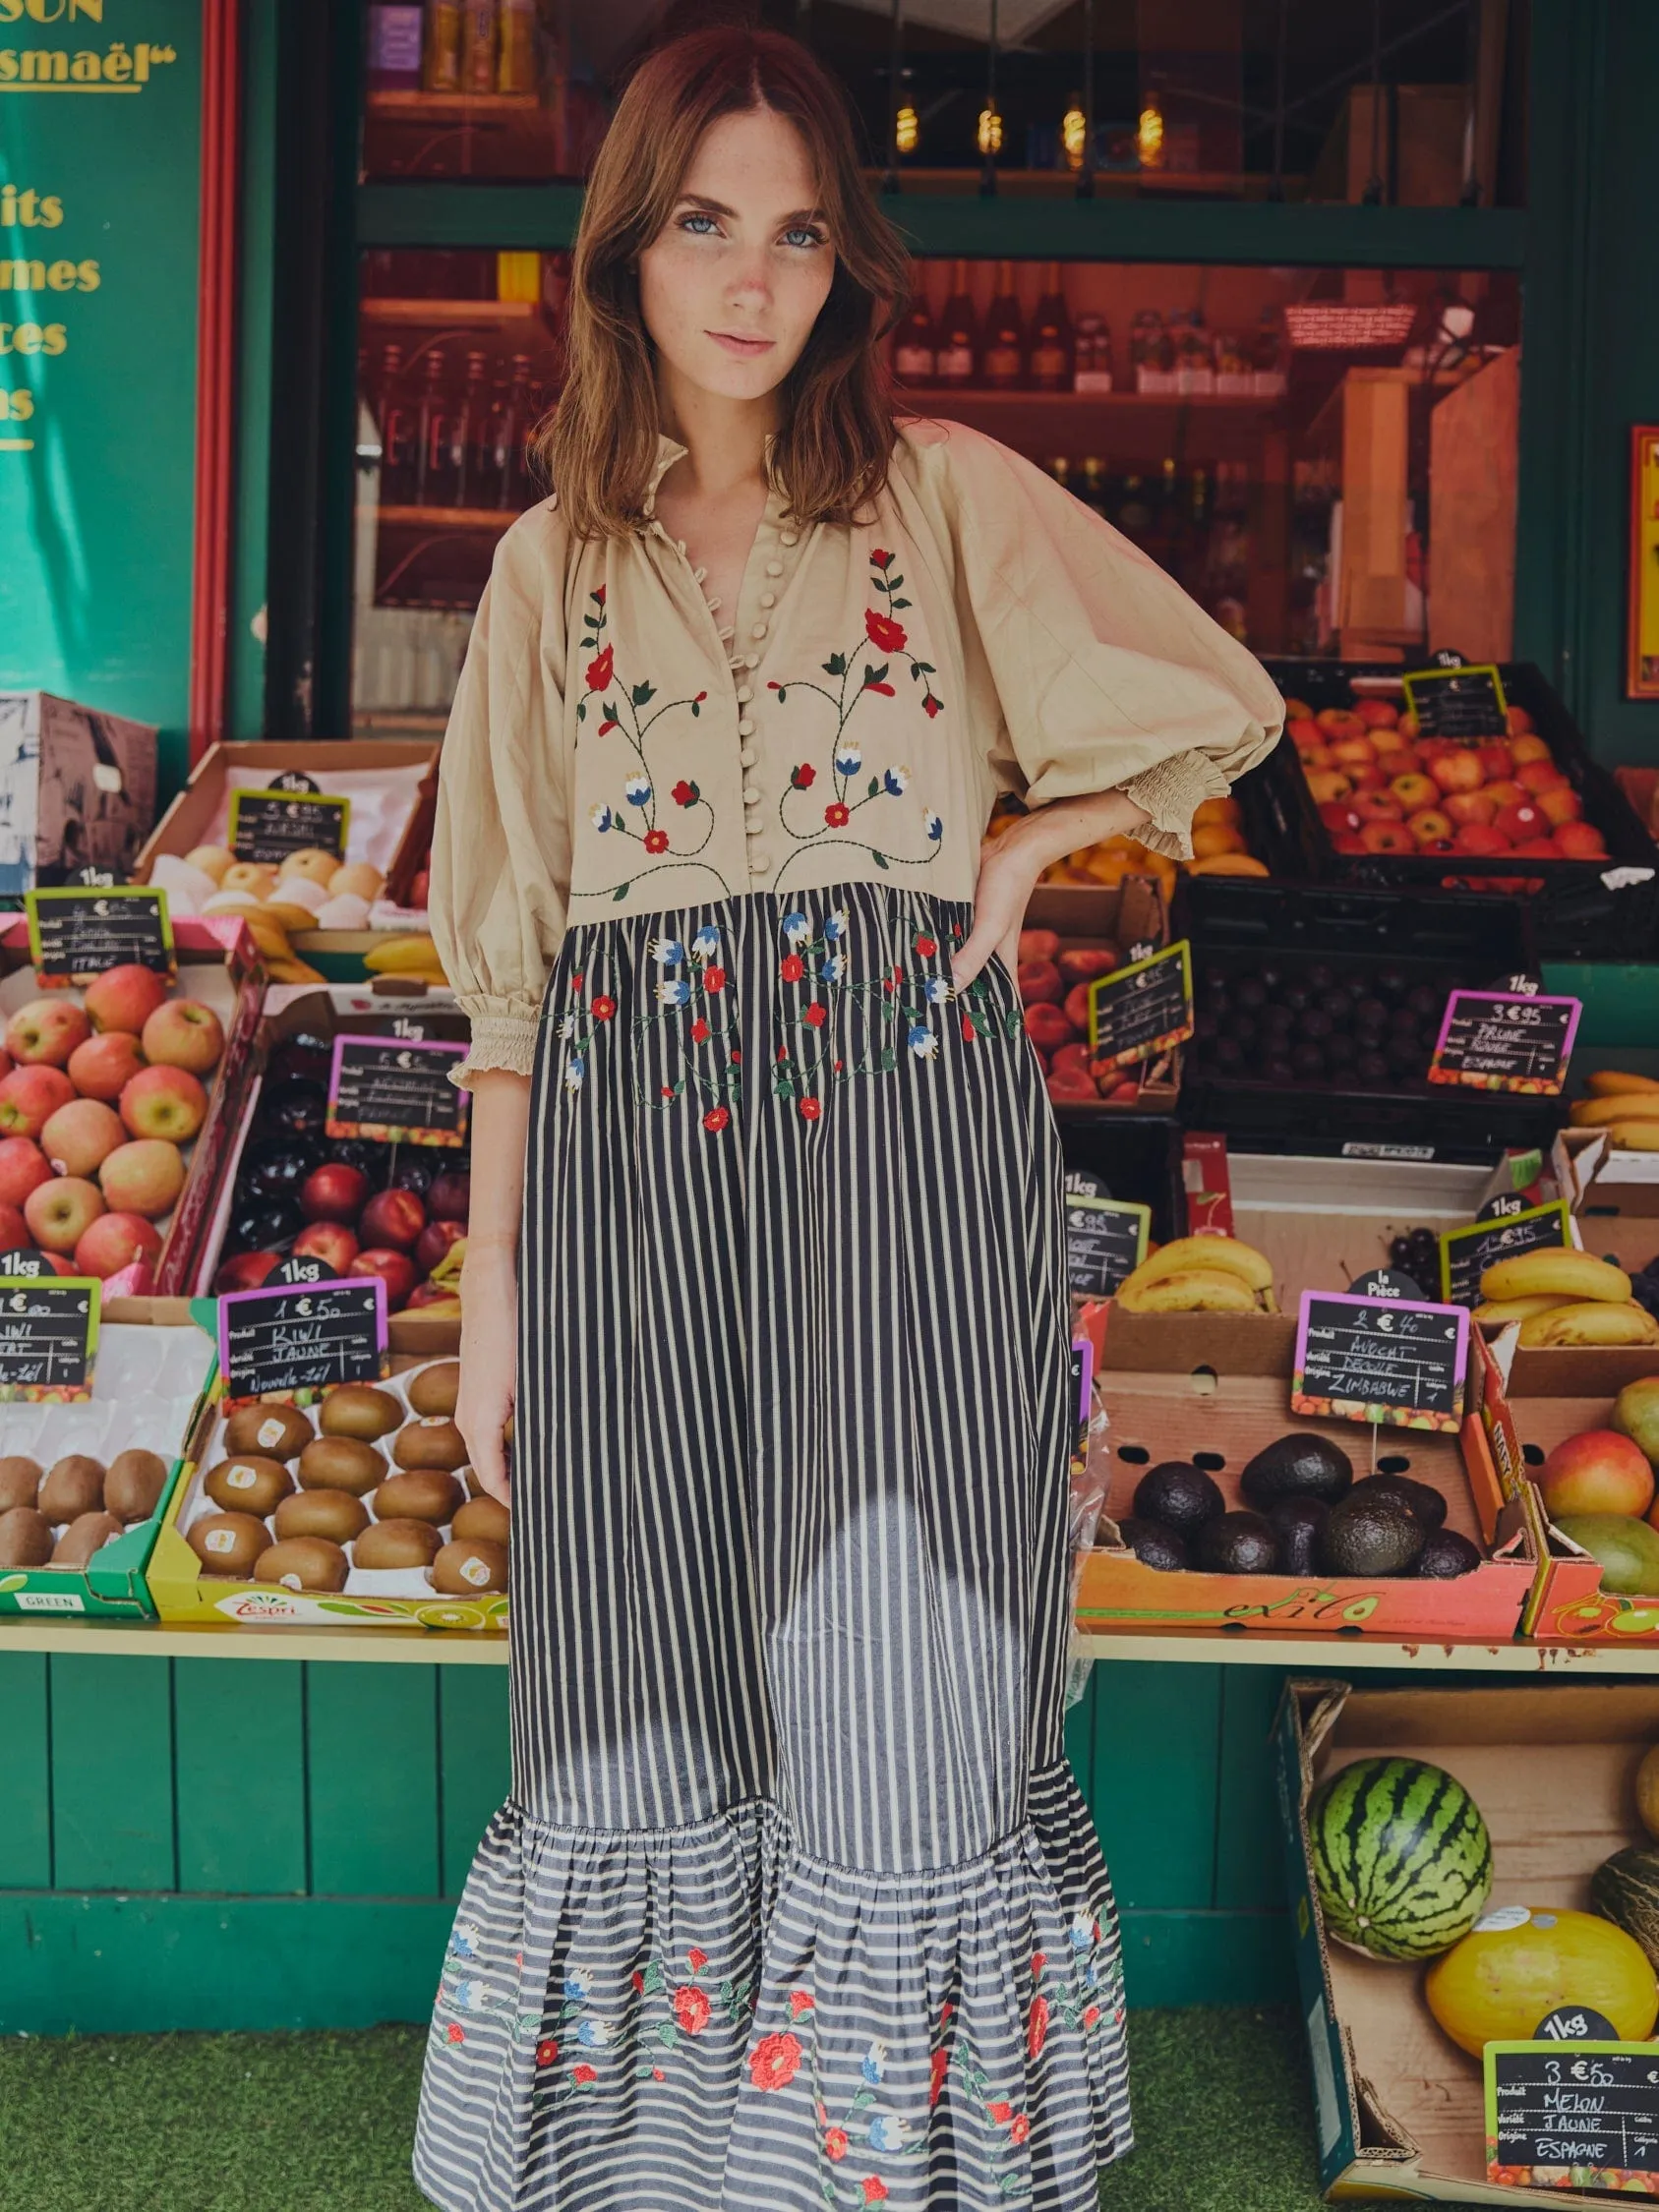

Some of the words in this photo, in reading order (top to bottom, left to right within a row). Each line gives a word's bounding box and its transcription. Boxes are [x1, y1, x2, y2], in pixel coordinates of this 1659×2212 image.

[80, 866, 114, 889] 1kg
[1510, 974, 1538, 997] 1kg
[392, 1018, 424, 1043] 1kg
[1065, 1172, 1097, 1197] 1kg
[1492, 1196, 1521, 1216] 1kg
[1, 1252, 40, 1278] 1kg
[280, 1258, 320, 1283] 1kg
[1378, 1270, 1389, 1284] la
[1368, 1283, 1400, 1298] Pièce
[272, 1322, 322, 1346] KIWI
[1329, 1374, 1410, 1398] ZIMBABWE
[26, 1596, 74, 1608] GREEN
[1544, 2013, 1588, 2041] 1kg
[1498, 2087, 1526, 2097] Produit
[1543, 2087, 1605, 2113] MELON
[1543, 2115, 1602, 2131] JAUNE
[1535, 2137, 1607, 2159] ESPAGNE
